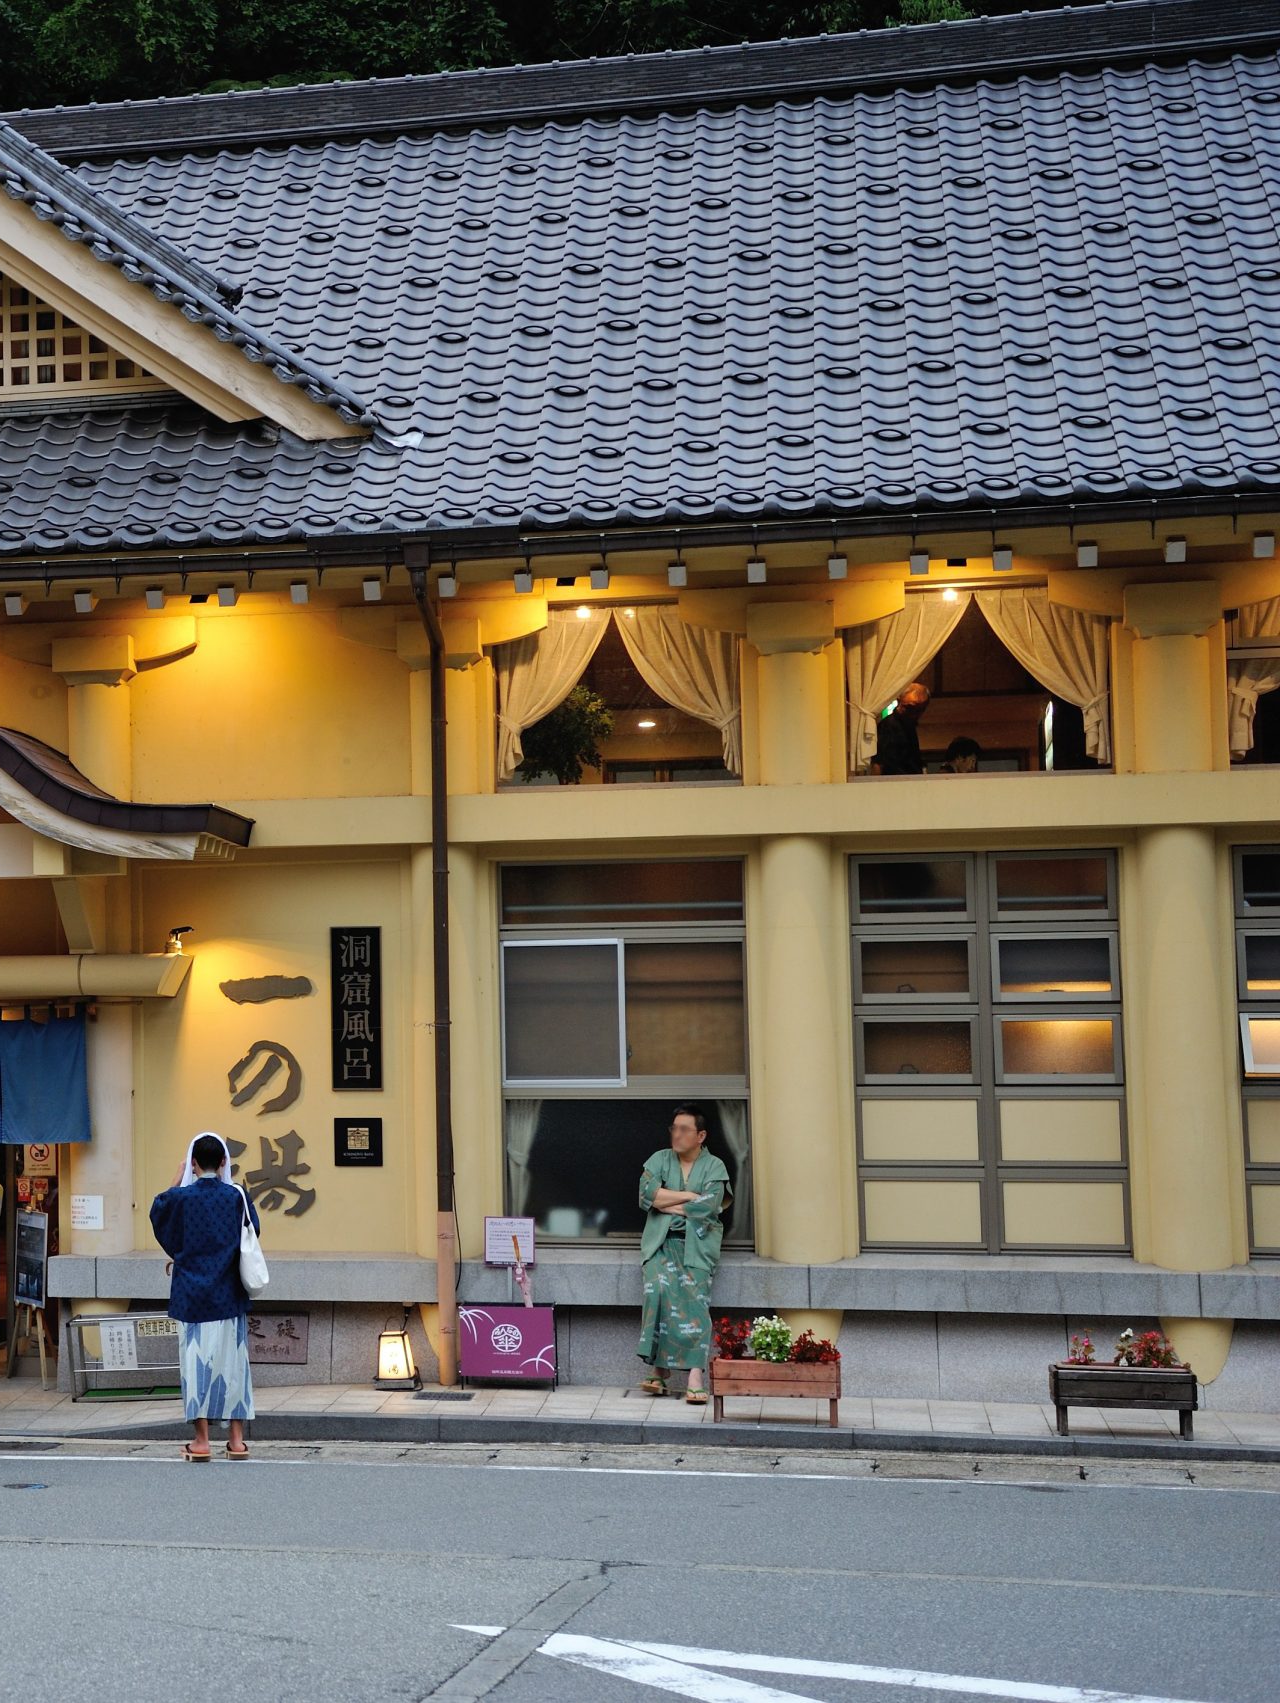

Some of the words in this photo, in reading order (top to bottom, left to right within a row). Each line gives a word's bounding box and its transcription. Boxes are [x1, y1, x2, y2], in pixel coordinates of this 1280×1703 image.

[219, 974, 317, 1217] 一の湯
[339, 934, 374, 1081] 洞窟風呂
